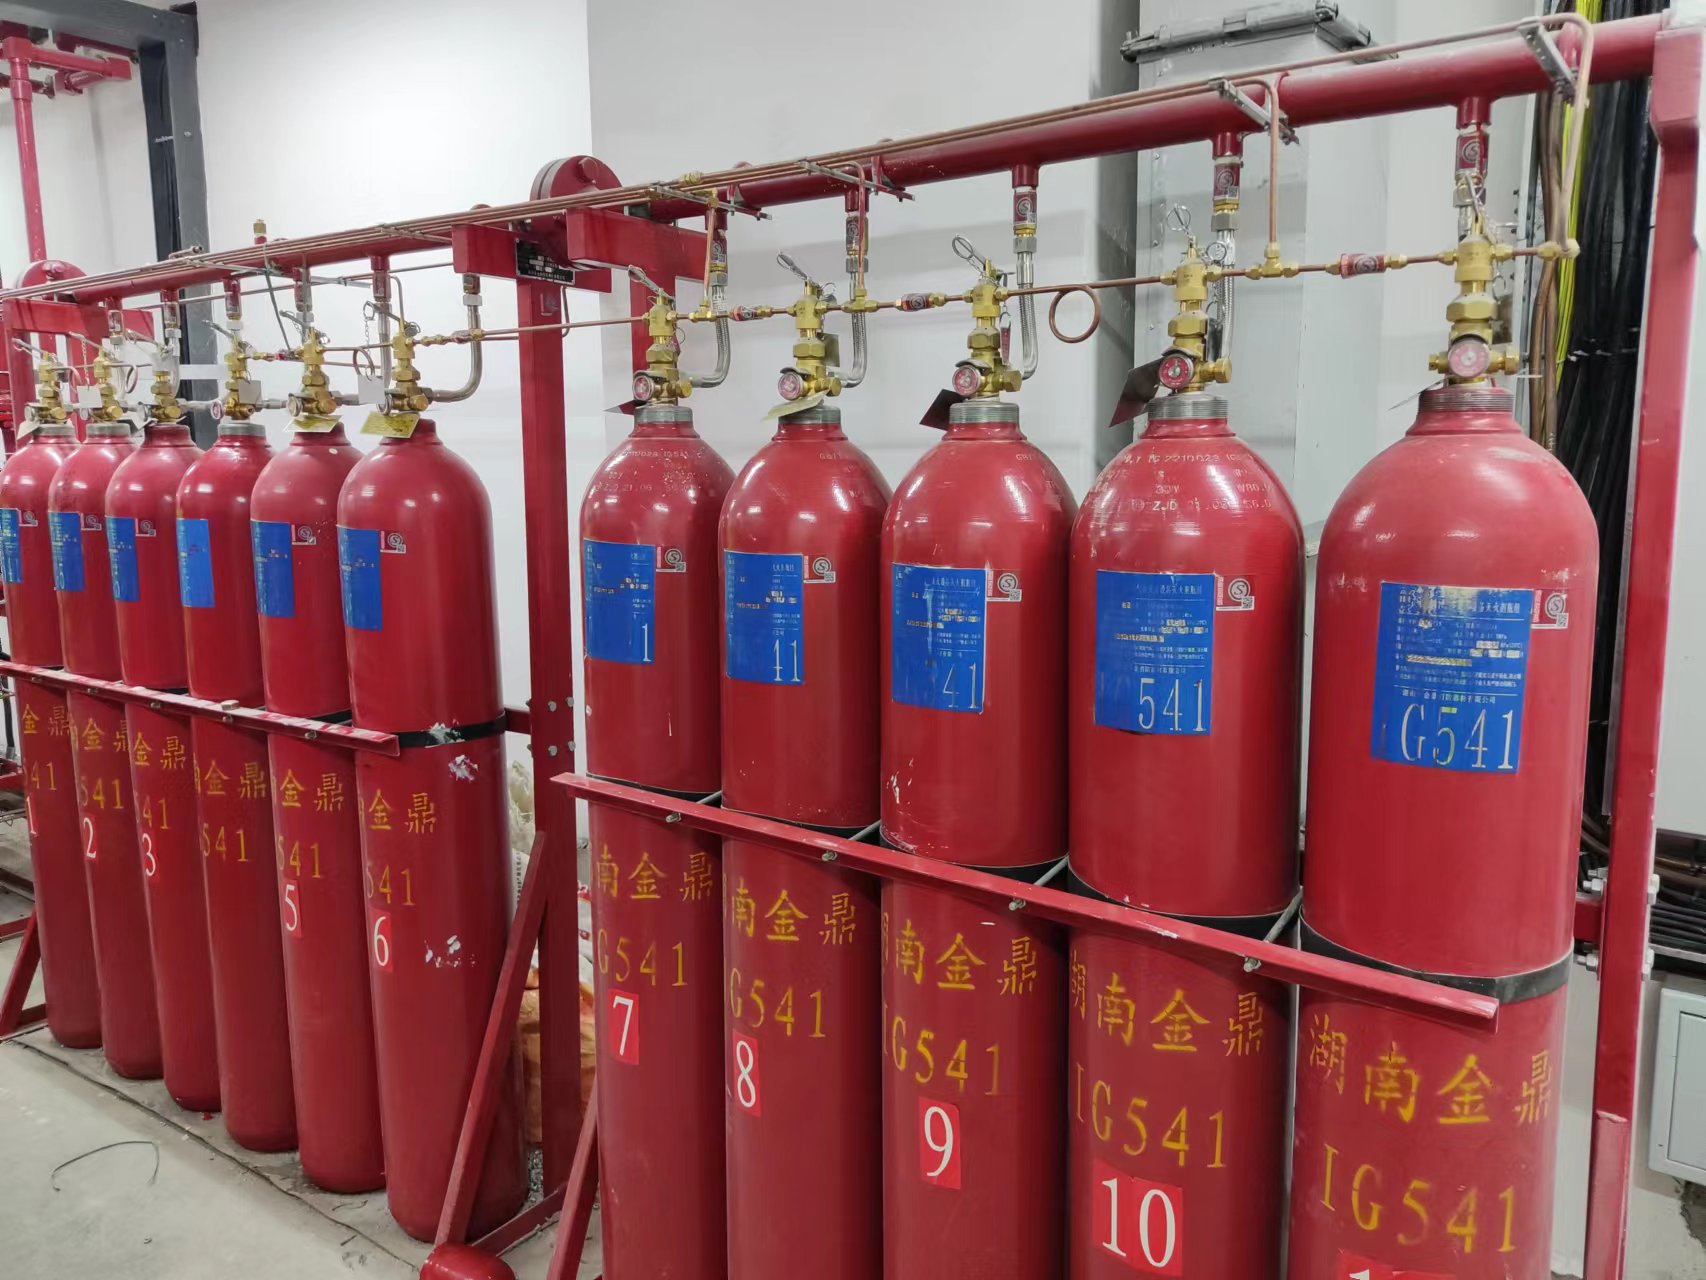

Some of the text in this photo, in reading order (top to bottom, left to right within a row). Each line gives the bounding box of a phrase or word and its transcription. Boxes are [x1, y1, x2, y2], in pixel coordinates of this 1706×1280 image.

[1138, 677, 1207, 732] 541
[133, 731, 187, 770] 金鼎
[1400, 702, 1514, 770] G541
[272, 768, 345, 812] 金鼎
[358, 788, 438, 835] 金鼎
[82, 816, 98, 860] 2
[141, 832, 157, 877] 3
[202, 821, 250, 863] 541
[284, 883, 299, 932] 5
[372, 915, 390, 968] 6
[612, 994, 635, 1057] 7
[729, 966, 827, 1038] G541
[735, 1039, 757, 1109] 8
[1309, 1013, 1552, 1127] 湖南金鼎
[923, 1105, 955, 1178] 9
[1075, 1062, 1228, 1170] IG541
[1101, 1176, 1178, 1269] 10
[1319, 1143, 1517, 1254] IG541
